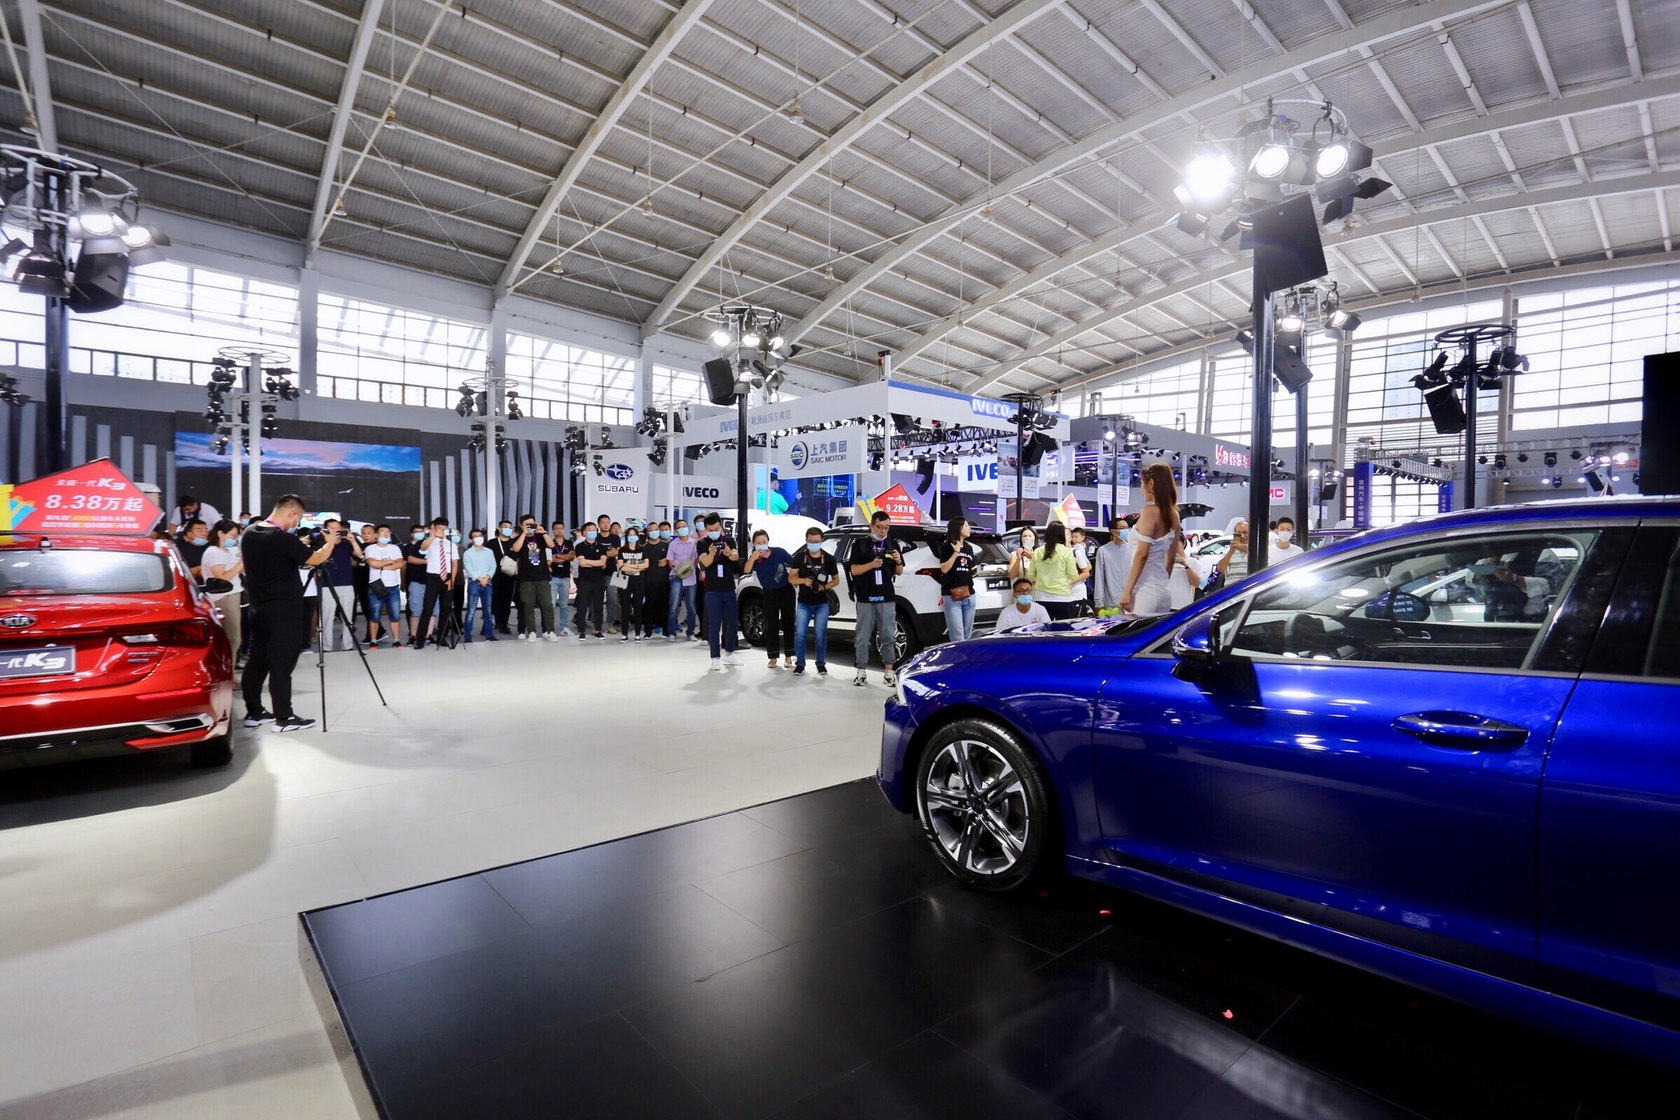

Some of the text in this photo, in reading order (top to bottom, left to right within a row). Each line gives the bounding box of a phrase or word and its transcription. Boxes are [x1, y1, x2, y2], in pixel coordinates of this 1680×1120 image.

[972, 399, 1011, 417] IVECO
[810, 440, 847, 456] 上汽集团
[825, 454, 847, 463] MOTOR
[967, 463, 998, 481] IVE
[597, 485, 639, 493] SUBARU
[44, 494, 144, 512] 8.38万起
[885, 503, 915, 514] 9.28万起
